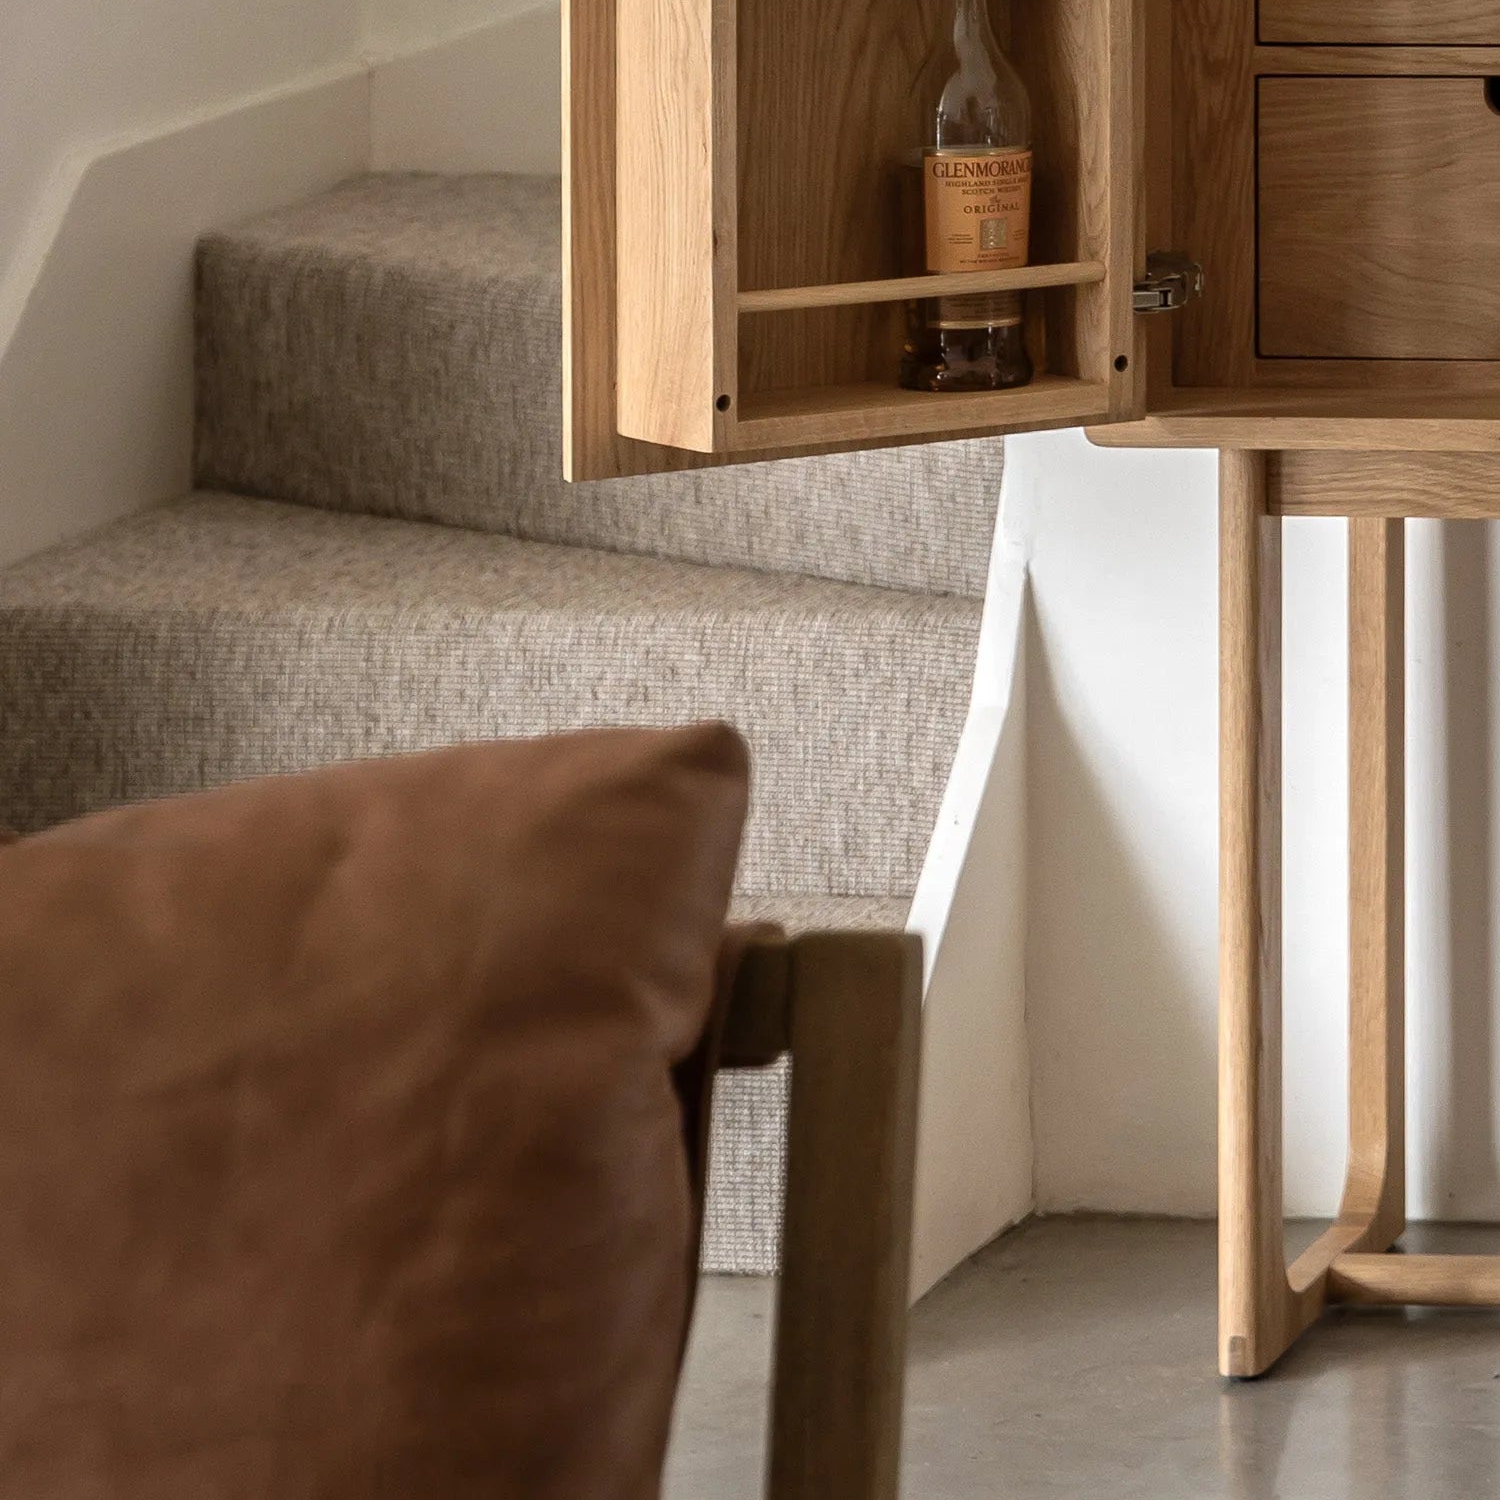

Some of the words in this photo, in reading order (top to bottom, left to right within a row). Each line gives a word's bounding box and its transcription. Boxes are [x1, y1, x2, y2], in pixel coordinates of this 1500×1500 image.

[945, 180, 991, 188] HIGHLAND
[961, 187, 995, 196] SCOTCH
[963, 202, 1020, 214] ORIGINAL
